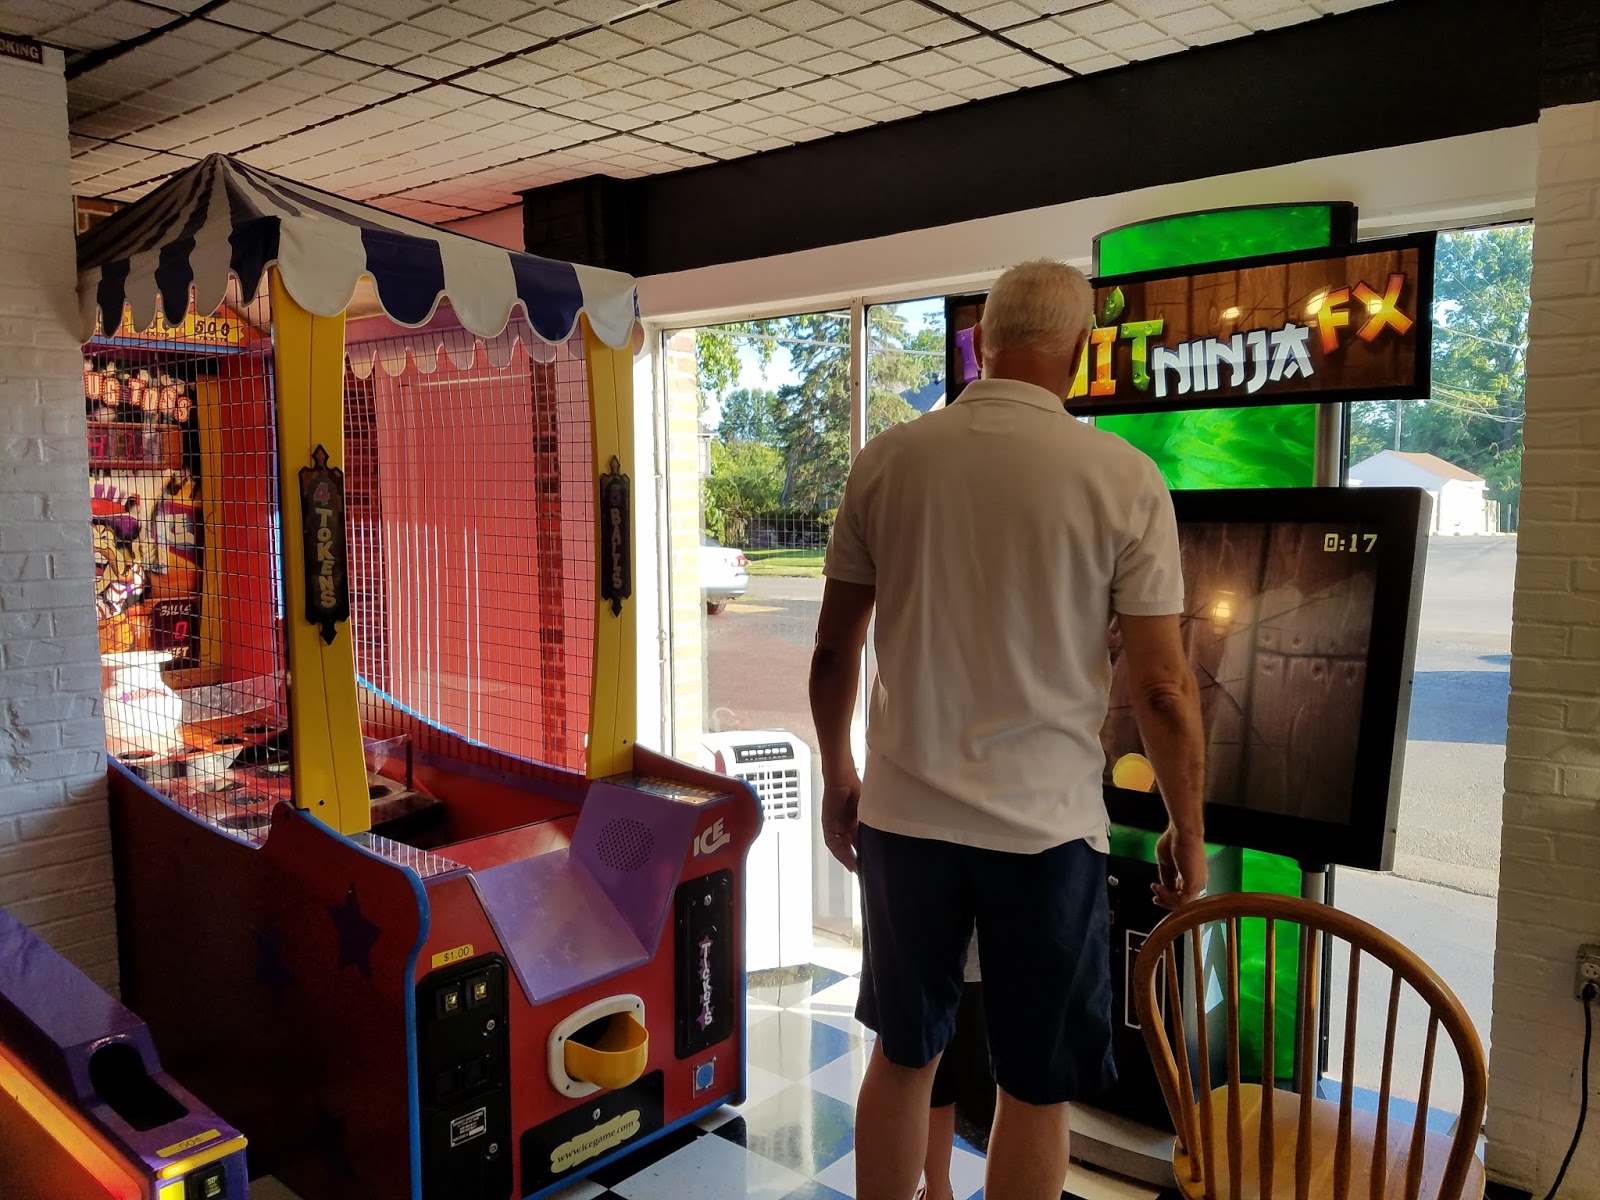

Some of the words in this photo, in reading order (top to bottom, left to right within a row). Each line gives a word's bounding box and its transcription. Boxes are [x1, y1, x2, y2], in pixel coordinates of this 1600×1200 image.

[195, 320, 230, 336] 500
[1151, 323, 1315, 398] NINJA
[1316, 273, 1413, 355] FX
[313, 481, 331, 506] 4
[314, 507, 337, 609] TOKENS
[610, 508, 623, 589] BALLS
[1323, 533, 1378, 553] 0:17
[693, 817, 731, 857] ICE
[443, 946, 470, 962] $1.00
[557, 1120, 635, 1163] www.icegame.com
